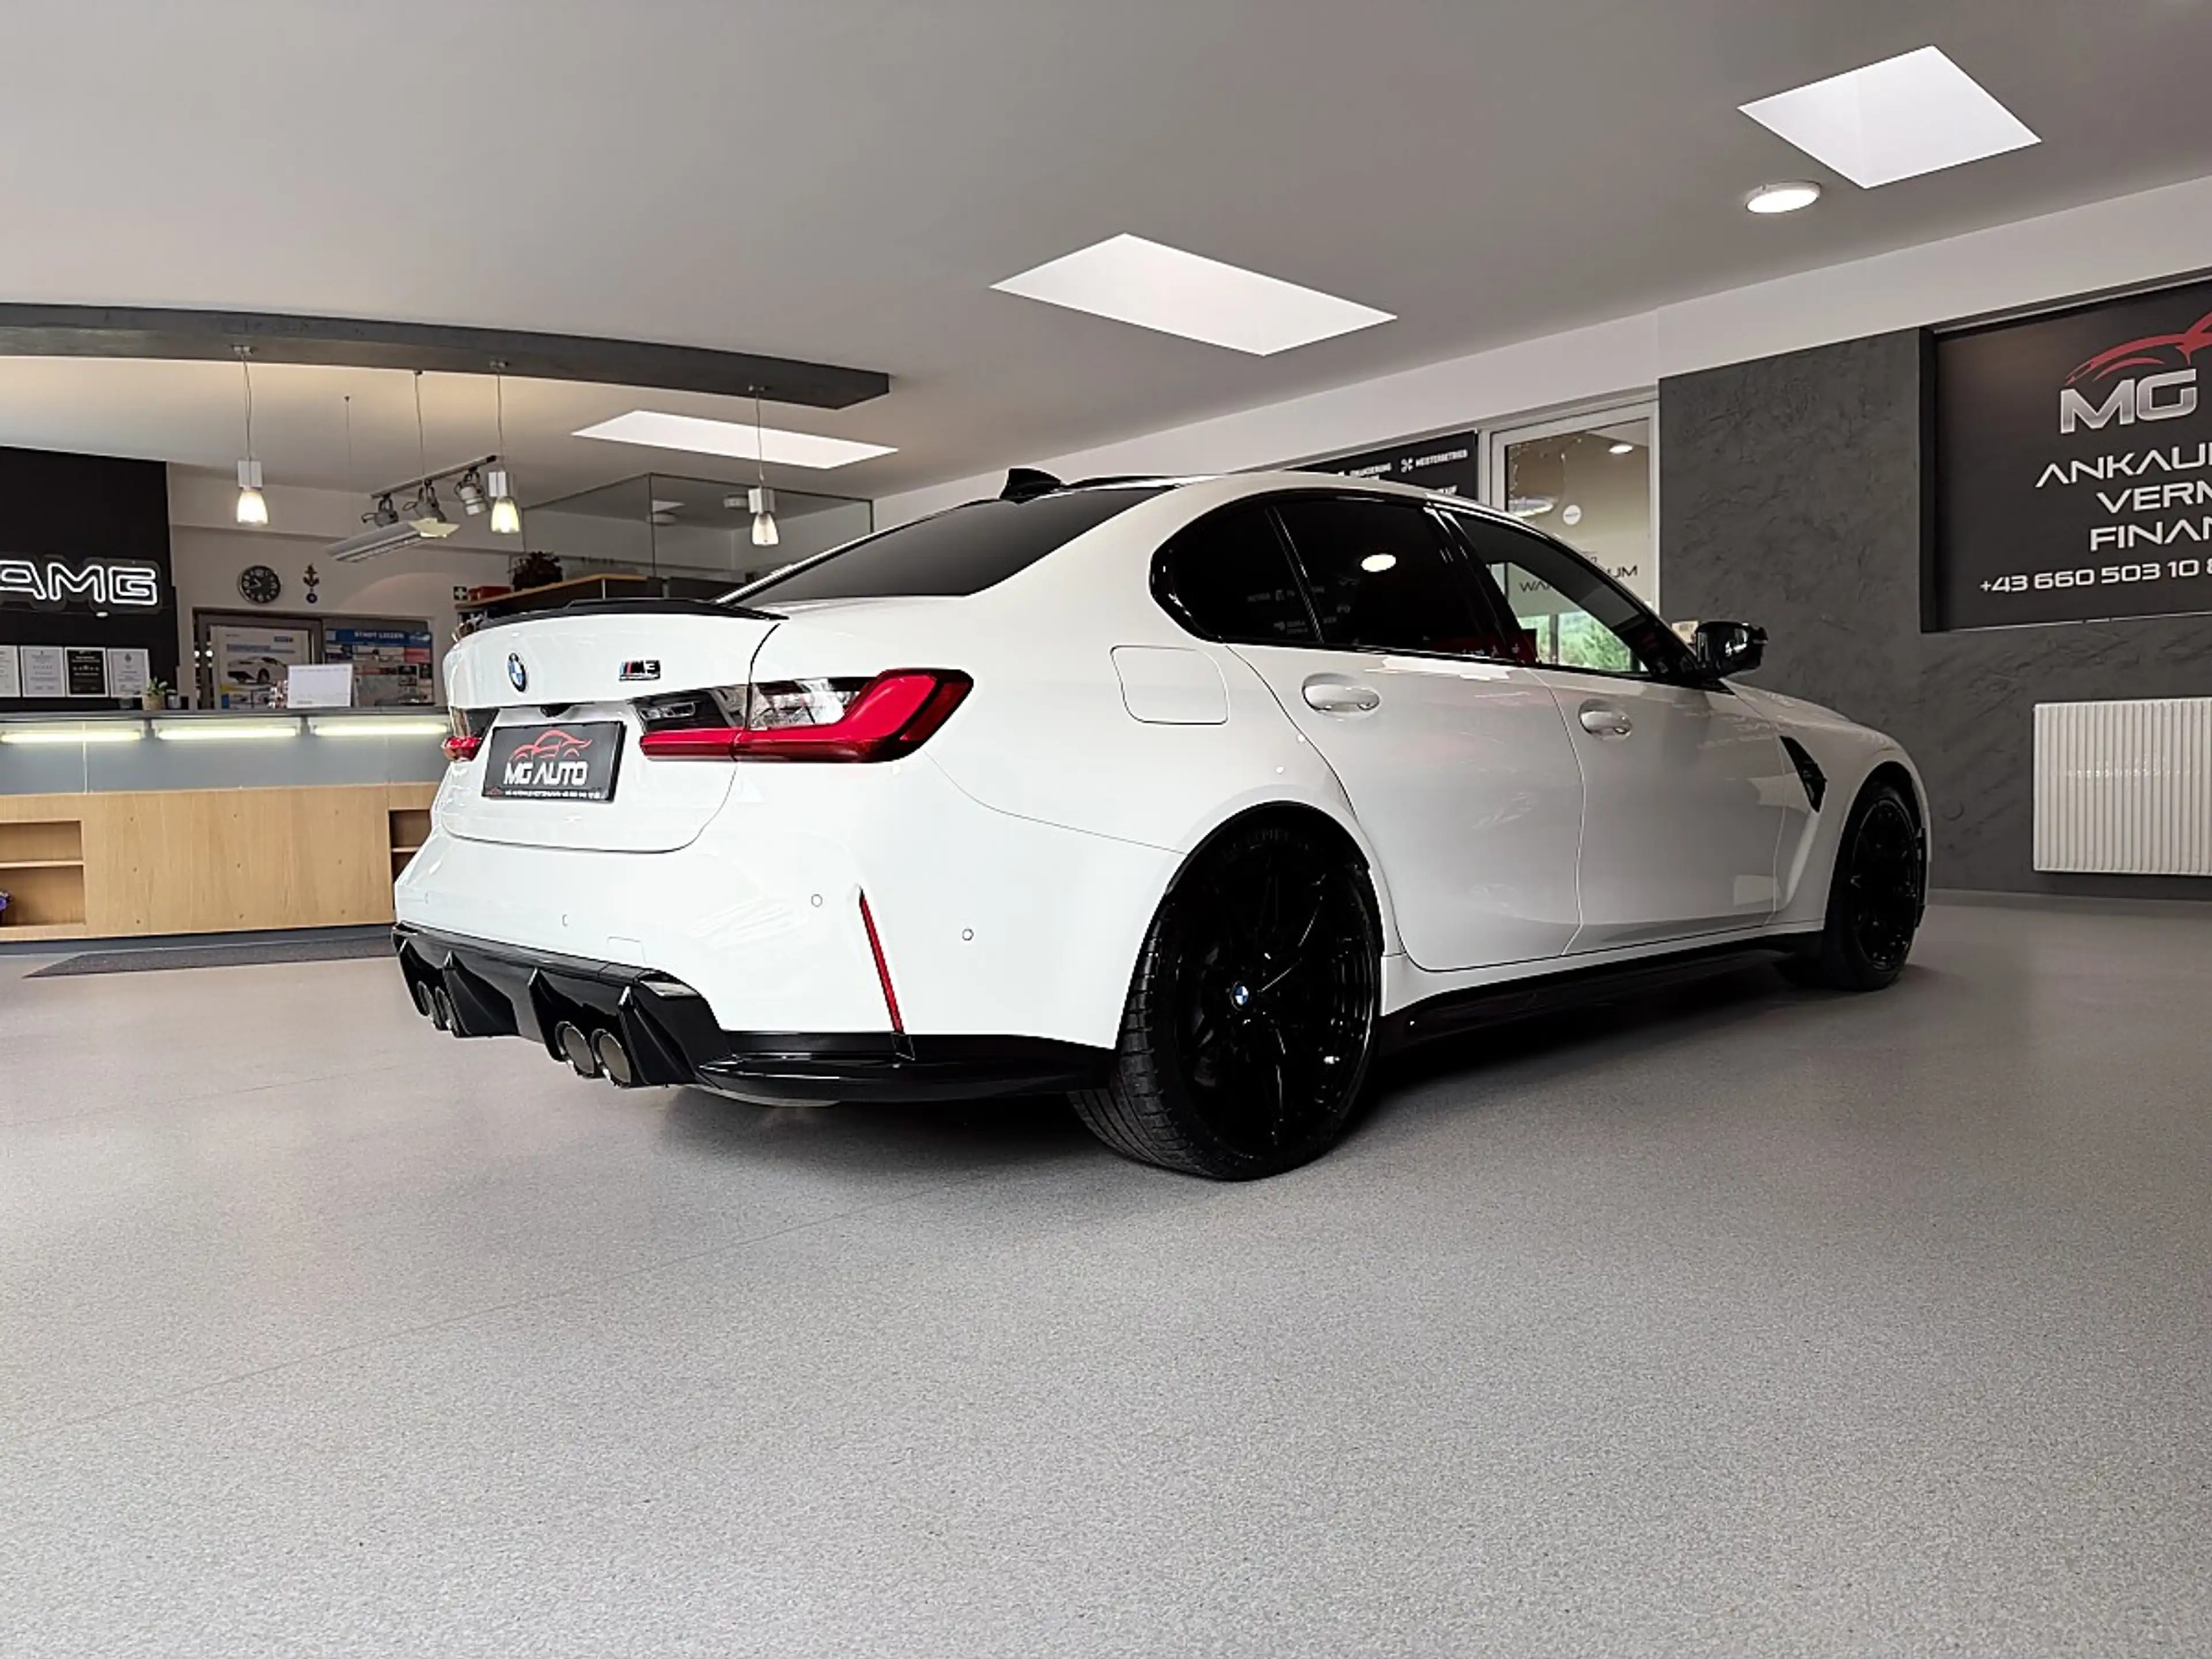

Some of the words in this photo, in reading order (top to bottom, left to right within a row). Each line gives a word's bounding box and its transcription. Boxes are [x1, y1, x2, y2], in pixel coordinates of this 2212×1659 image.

[2060, 369, 2198, 434] MG
[2035, 442, 2212, 488] ANKAU
[0, 560, 157, 605] AMG
[1980, 576, 2028, 593] +43
[2034, 569, 2095, 590] 660
[2101, 562, 2161, 584] 503
[2167, 559, 2199, 577] 10
[503, 761, 533, 785] MG
[533, 761, 589, 786] AUTO
